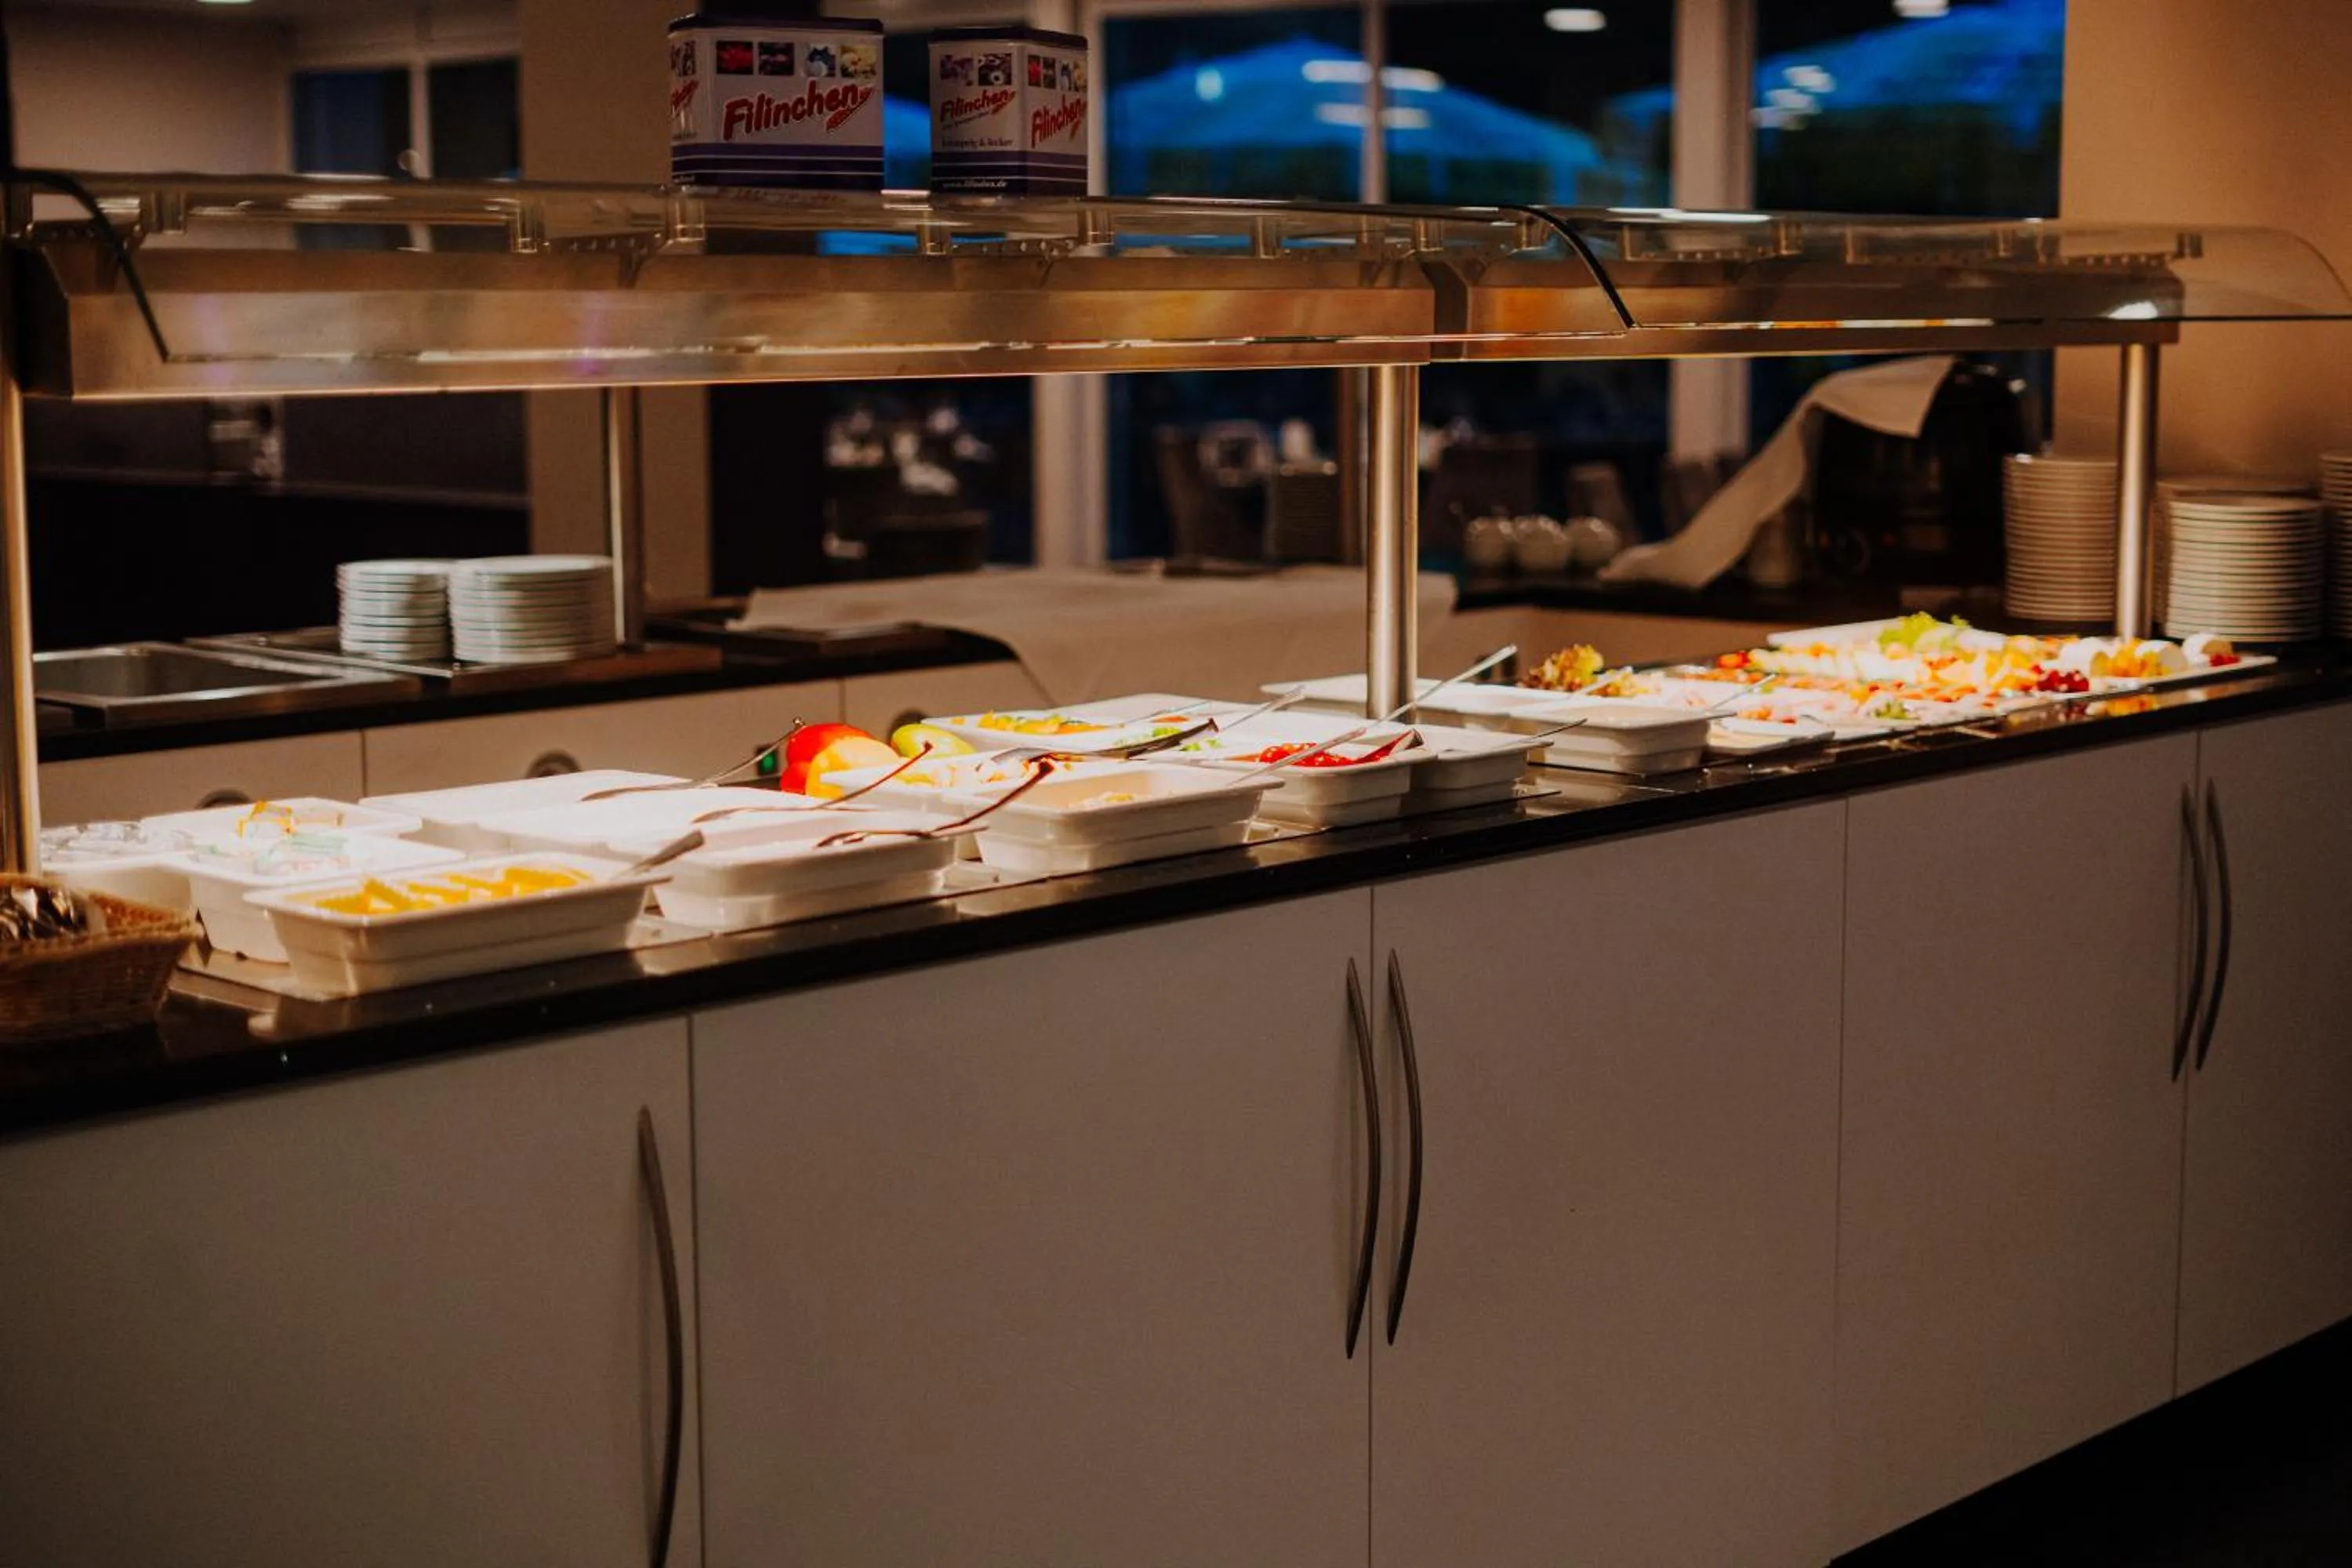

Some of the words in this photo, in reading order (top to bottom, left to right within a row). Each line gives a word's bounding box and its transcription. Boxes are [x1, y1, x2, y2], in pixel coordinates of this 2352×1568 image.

[723, 80, 858, 140] Filinchen
[940, 89, 1008, 122] Filinchen
[1032, 94, 1081, 148] Filinchen
